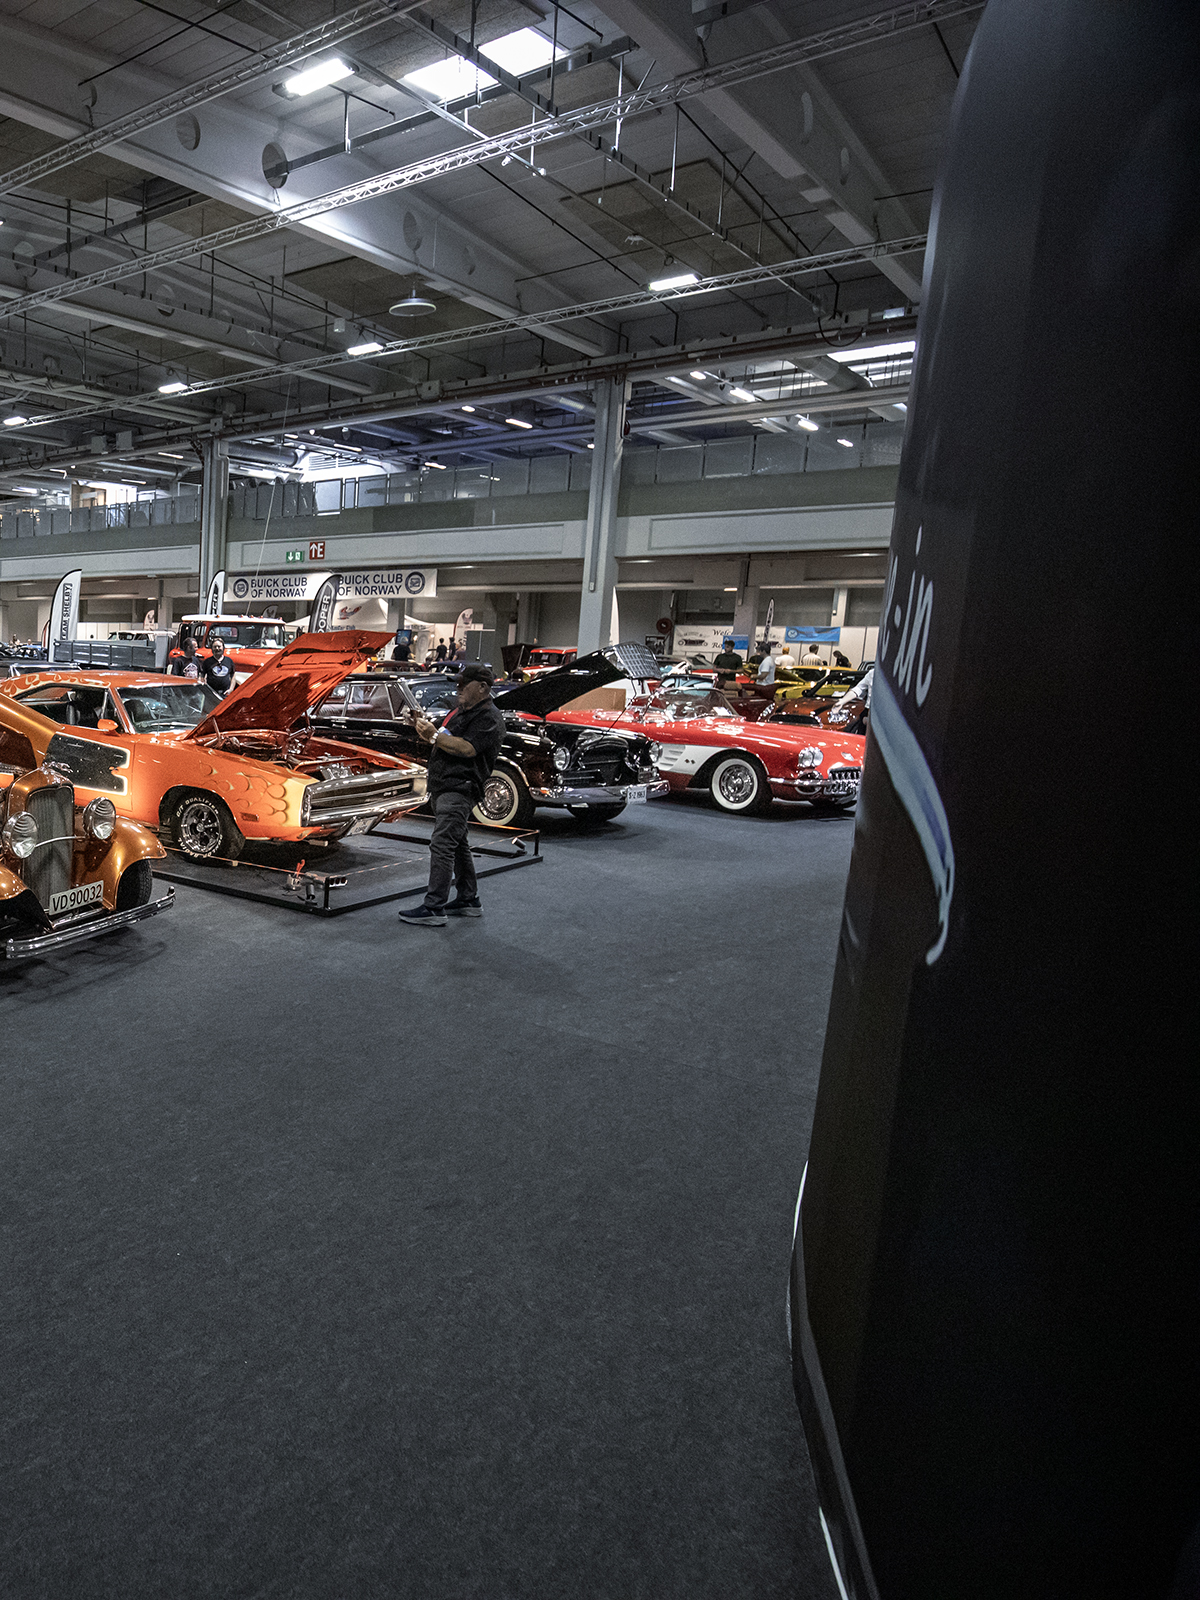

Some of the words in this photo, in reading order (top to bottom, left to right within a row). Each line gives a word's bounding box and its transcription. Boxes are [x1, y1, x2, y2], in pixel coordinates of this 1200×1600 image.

[317, 542, 324, 558] E
[251, 578, 280, 588] BUICK
[283, 576, 308, 587] CLUB
[339, 574, 371, 586] BUICK
[373, 573, 403, 584] CLUB
[251, 588, 263, 598] OF
[265, 587, 307, 598] NORWAY
[338, 585, 352, 596] OF
[354, 584, 402, 596] NORWAY
[63, 585, 72, 618] SHELBY
[69, 883, 102, 908] 90032
